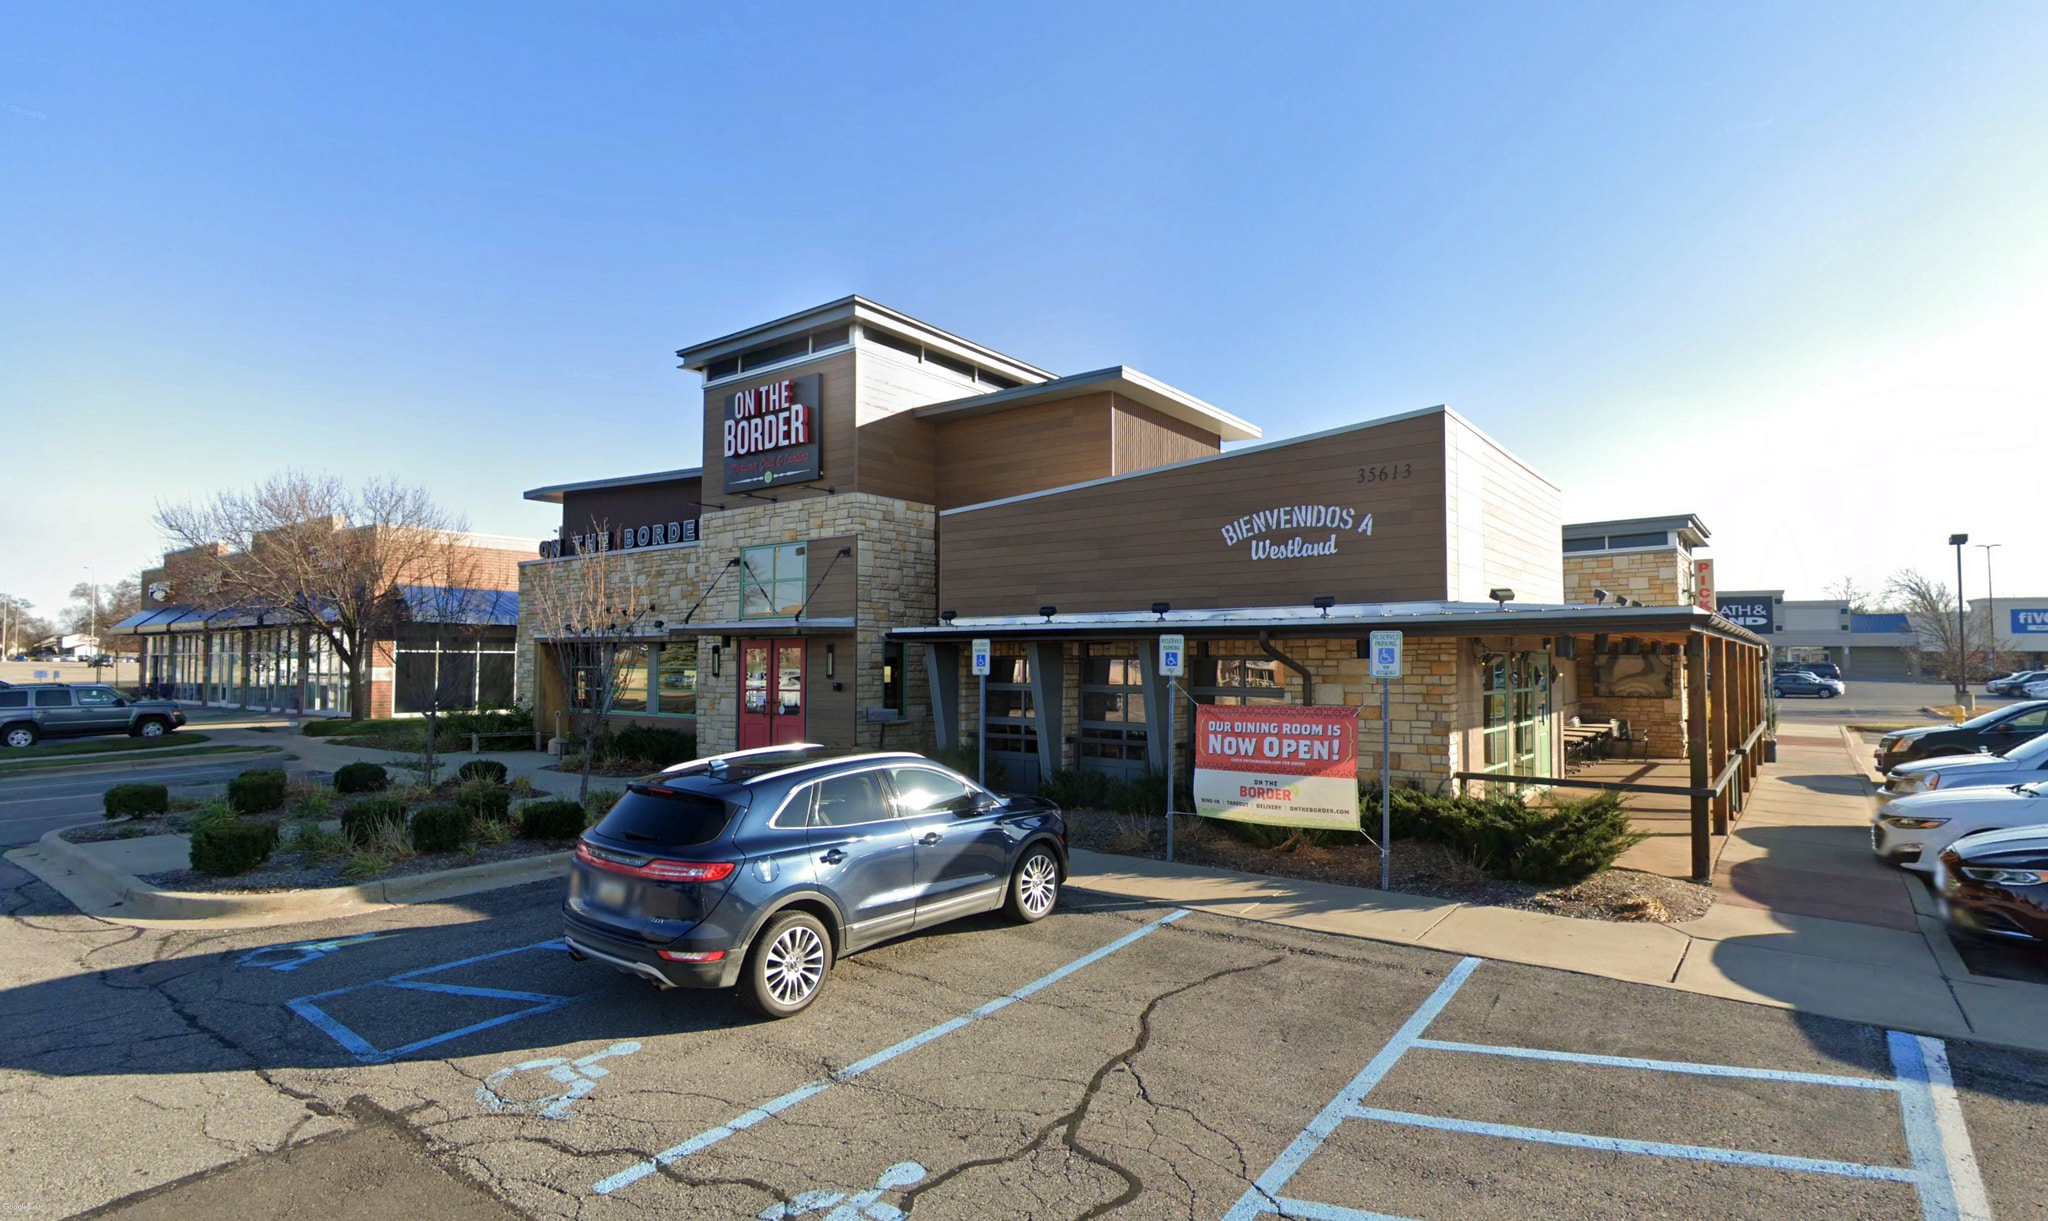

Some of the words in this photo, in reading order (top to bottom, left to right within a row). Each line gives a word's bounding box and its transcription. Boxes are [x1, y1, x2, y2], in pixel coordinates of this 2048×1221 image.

[734, 388, 757, 419] ON
[760, 379, 793, 413] THE
[724, 403, 807, 458] BORDER
[1357, 464, 1412, 483] 35613
[1221, 504, 1355, 546] BIENVENIDOS
[1357, 512, 1373, 536] A
[539, 538, 562, 558] ON
[572, 531, 610, 556] THE
[624, 519, 703, 549] BORDE
[1251, 534, 1338, 560] Westland
[1719, 604, 1752, 616] ATH
[1753, 604, 1767, 616] &
[1208, 721, 1231, 732] OUR
[1234, 722, 1279, 734] DINING
[1282, 723, 1323, 736] ROOM
[1327, 724, 1341, 736] IS
[1208, 733, 1257, 757] NOW
[1263, 736, 1340, 761] OPEN!
[1240, 785, 1292, 801] BORDER
[1226, 800, 1249, 808] TAKEOUT
[1256, 803, 1282, 811] DELIVERY
[1289, 806, 1350, 815] ONTHEBORDER.COM
